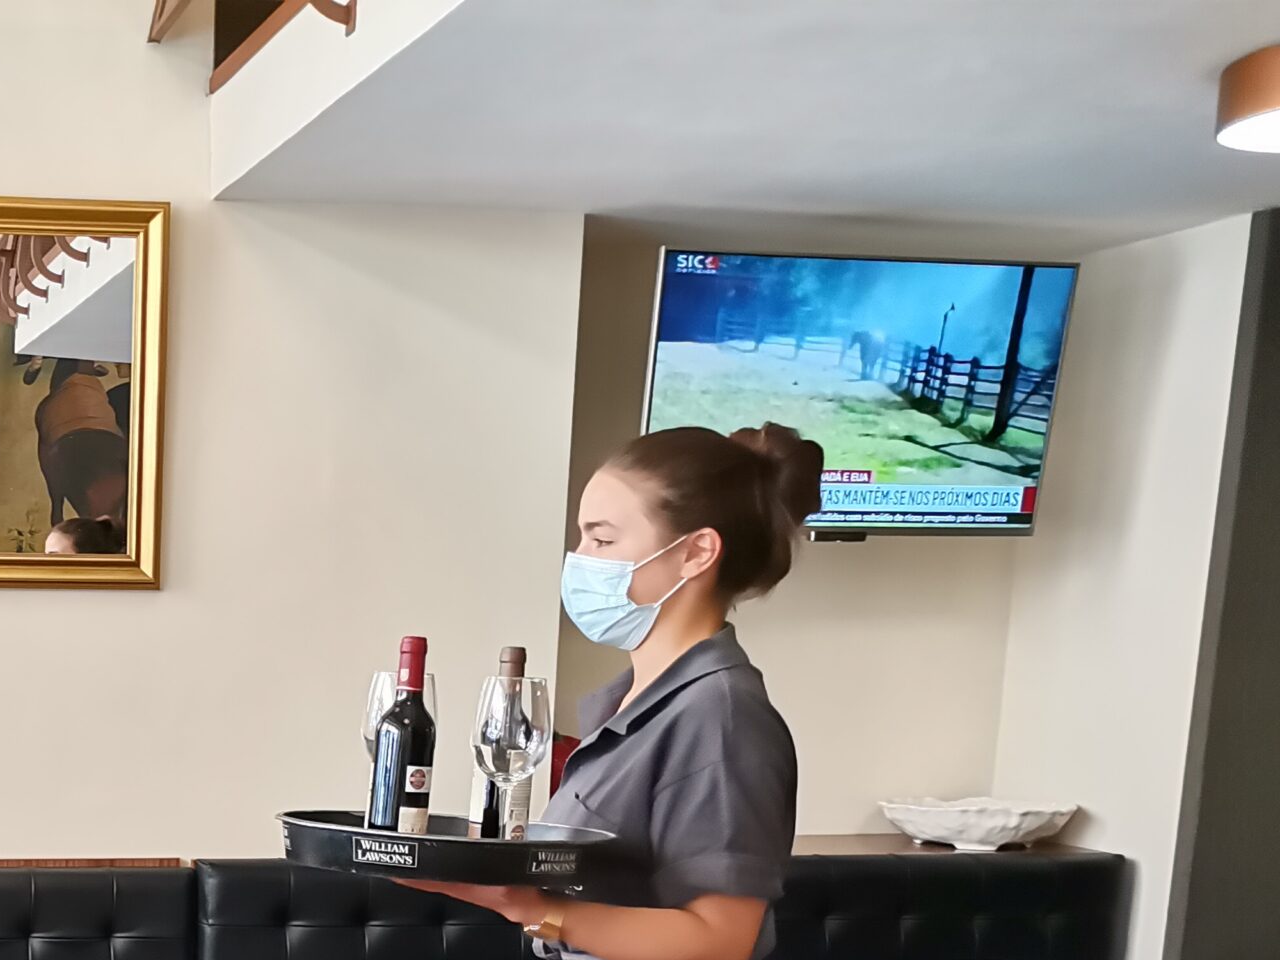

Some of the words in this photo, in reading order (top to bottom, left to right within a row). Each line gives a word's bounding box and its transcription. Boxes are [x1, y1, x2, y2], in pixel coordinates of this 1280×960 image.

[842, 472, 850, 482] E
[851, 472, 869, 482] EUA
[841, 486, 905, 506] MANTÊM-SE
[907, 490, 931, 506] NOS
[932, 487, 989, 507] PRÓXIMOS
[990, 491, 1020, 507] DIAS
[360, 839, 409, 854] WILLIAM
